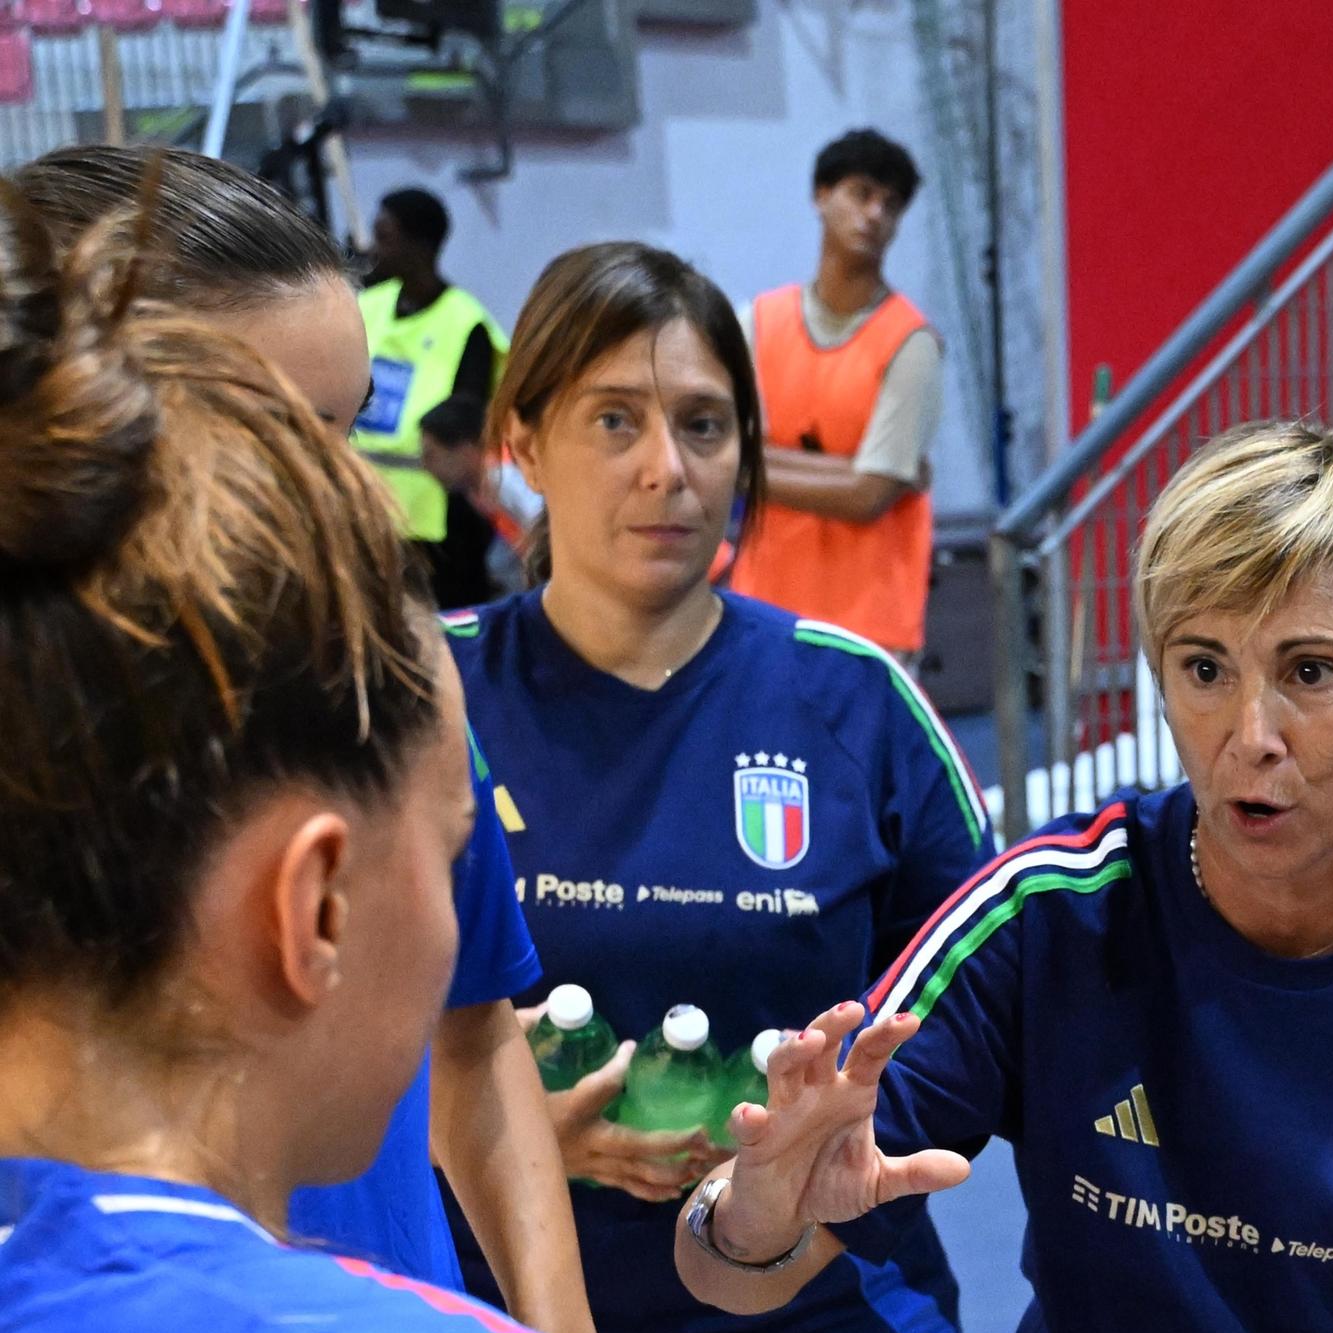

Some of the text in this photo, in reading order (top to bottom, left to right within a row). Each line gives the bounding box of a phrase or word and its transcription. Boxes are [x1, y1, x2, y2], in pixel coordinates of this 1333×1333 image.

[741, 776, 801, 799] ITALIA
[536, 873, 624, 904] Poste
[652, 885, 724, 906] Telepass
[735, 888, 784, 914] eni
[1105, 1192, 1161, 1231] TIM
[1166, 1202, 1260, 1245] Poste
